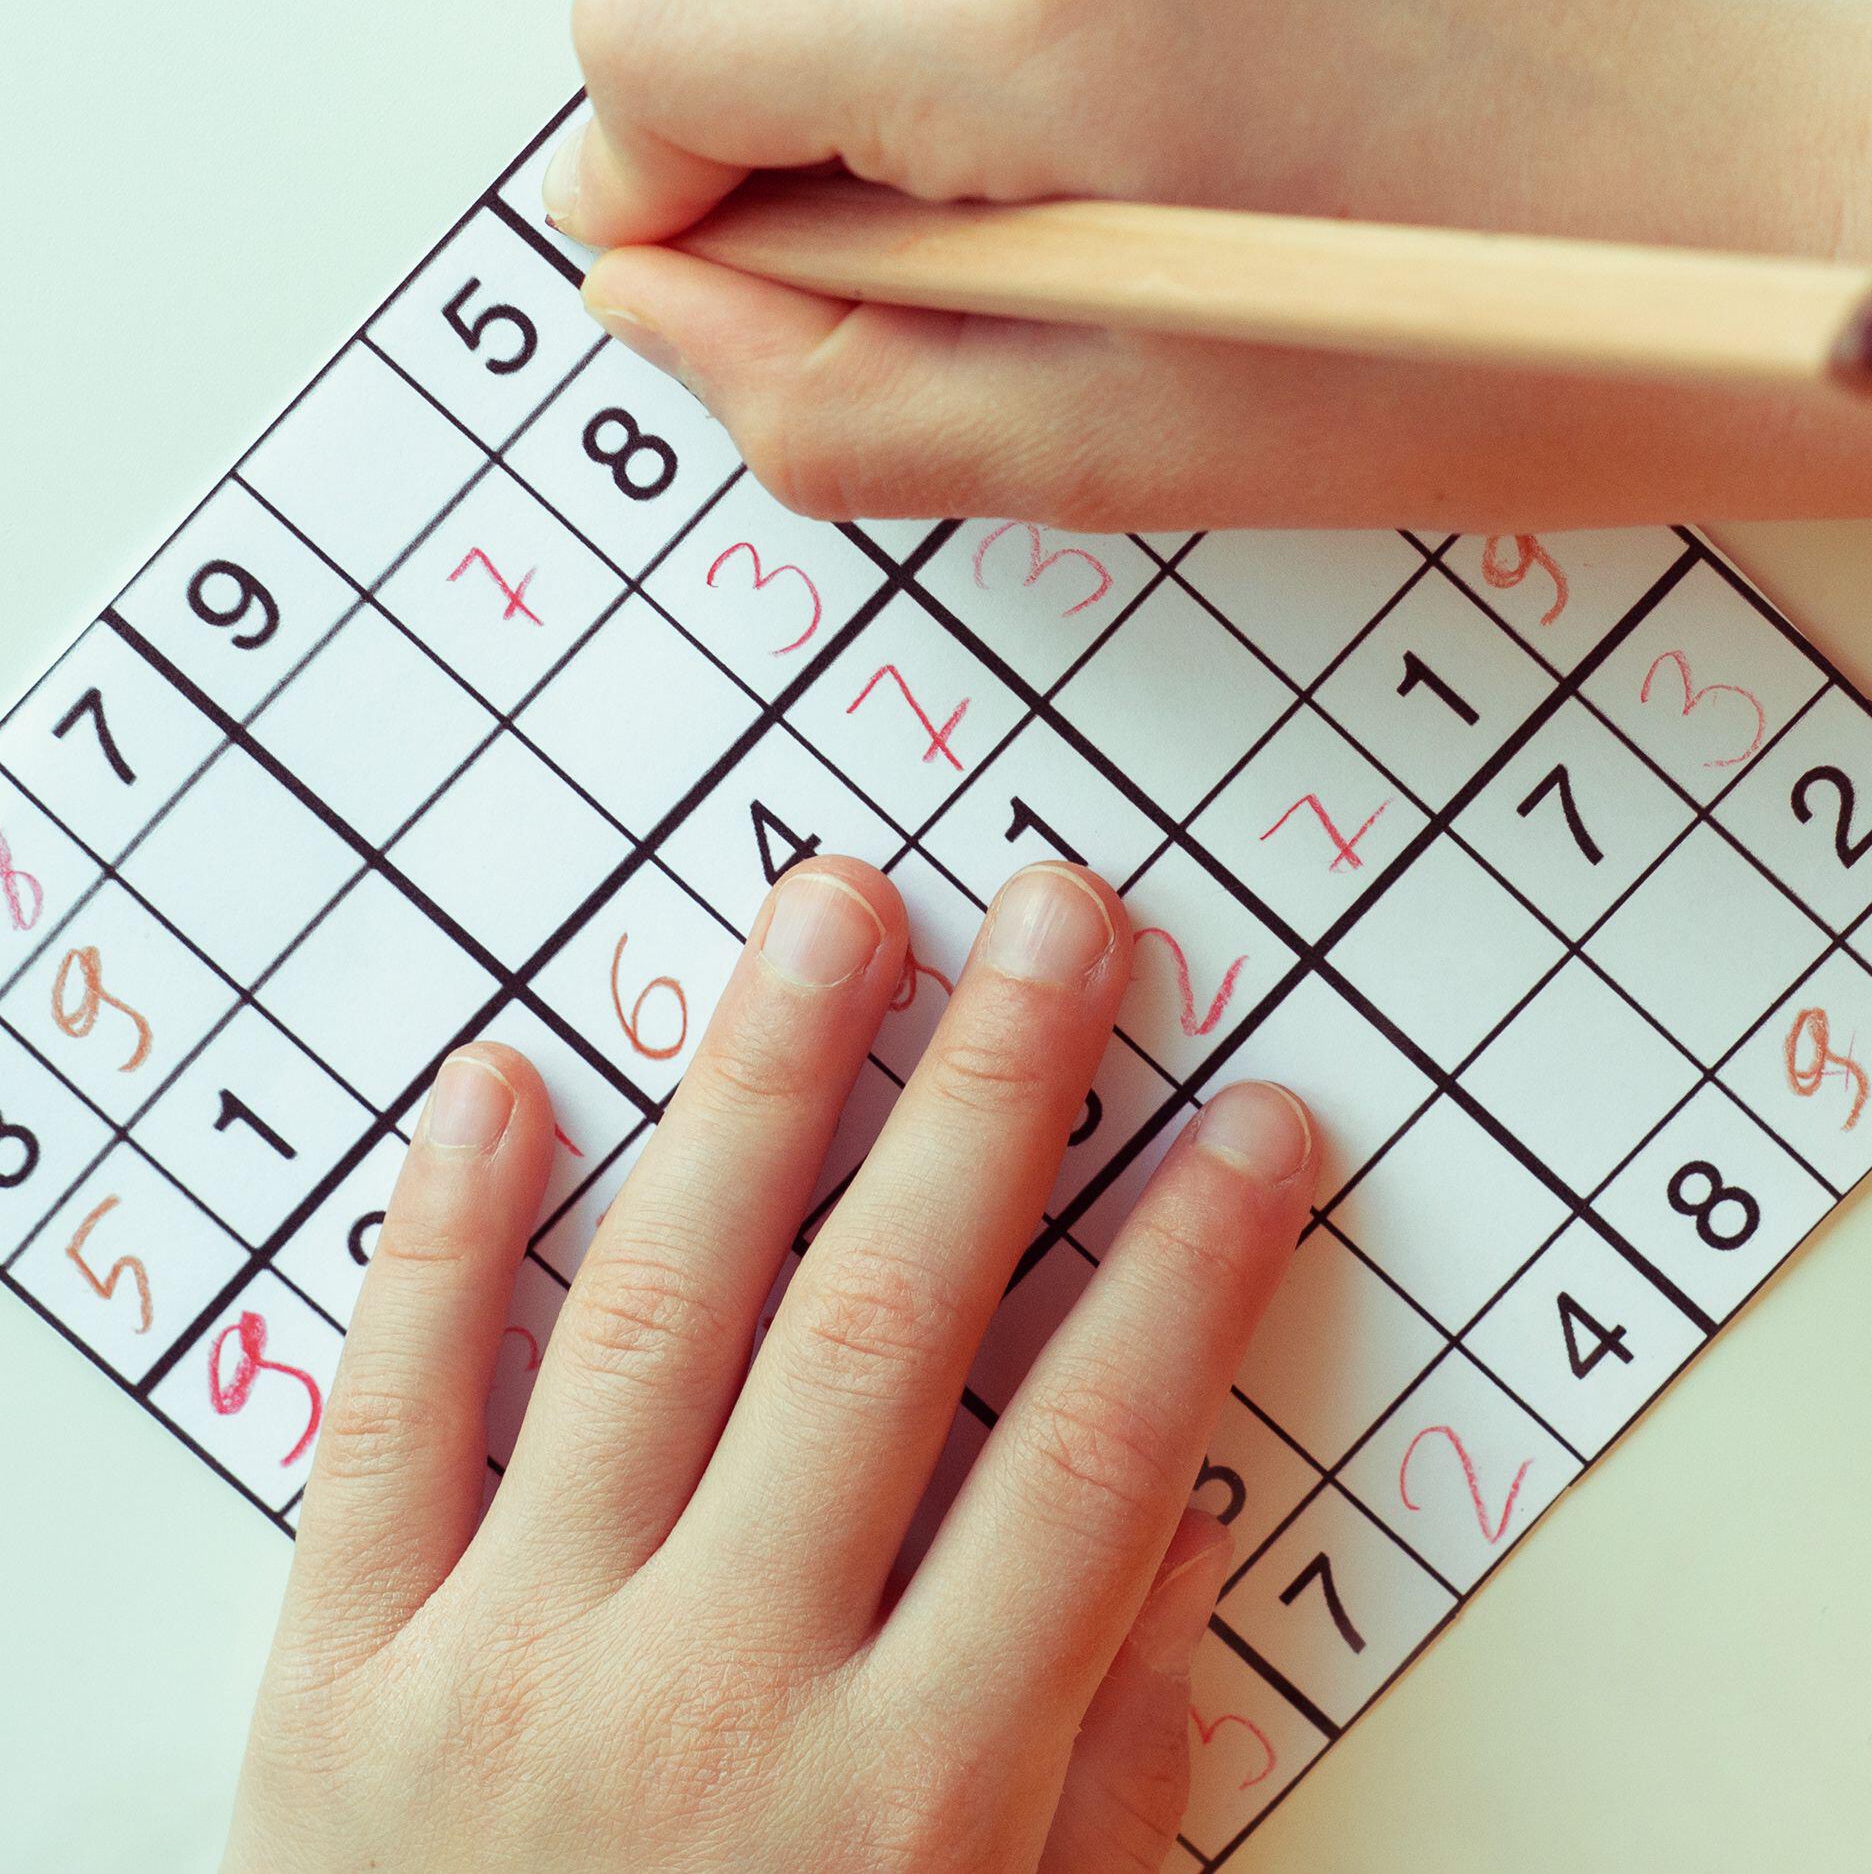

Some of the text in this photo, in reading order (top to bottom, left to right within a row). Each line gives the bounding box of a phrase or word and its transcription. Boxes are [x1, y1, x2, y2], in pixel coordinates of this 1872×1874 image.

[441, 277, 539, 376] 5
[581, 406, 679, 502] 8
[186, 559, 281, 651] 9
[446, 544, 545, 628] 7
[704, 541, 824, 658] 3
[971, 520, 1114, 618] 3
[52, 687, 137, 786] 7
[844, 663, 972, 773] 7
[1395, 649, 1481, 727] 1
[1638, 649, 1768, 769] 3
[749, 798, 822, 887] 4
[1003, 795, 1090, 869] 1
[1257, 791, 1397, 874] 7
[1515, 762, 1605, 867] 7
[609, 932, 690, 1062] 6
[1131, 926, 1250, 1038] 2
[213, 1088, 297, 1161] 1
[1665, 1159, 1761, 1252] 8
[65, 1194, 154, 1335] 5
[1555, 1290, 1636, 1381] 4
[1399, 1425, 1537, 1546] 2
[1276, 1550, 1367, 1656] 7
